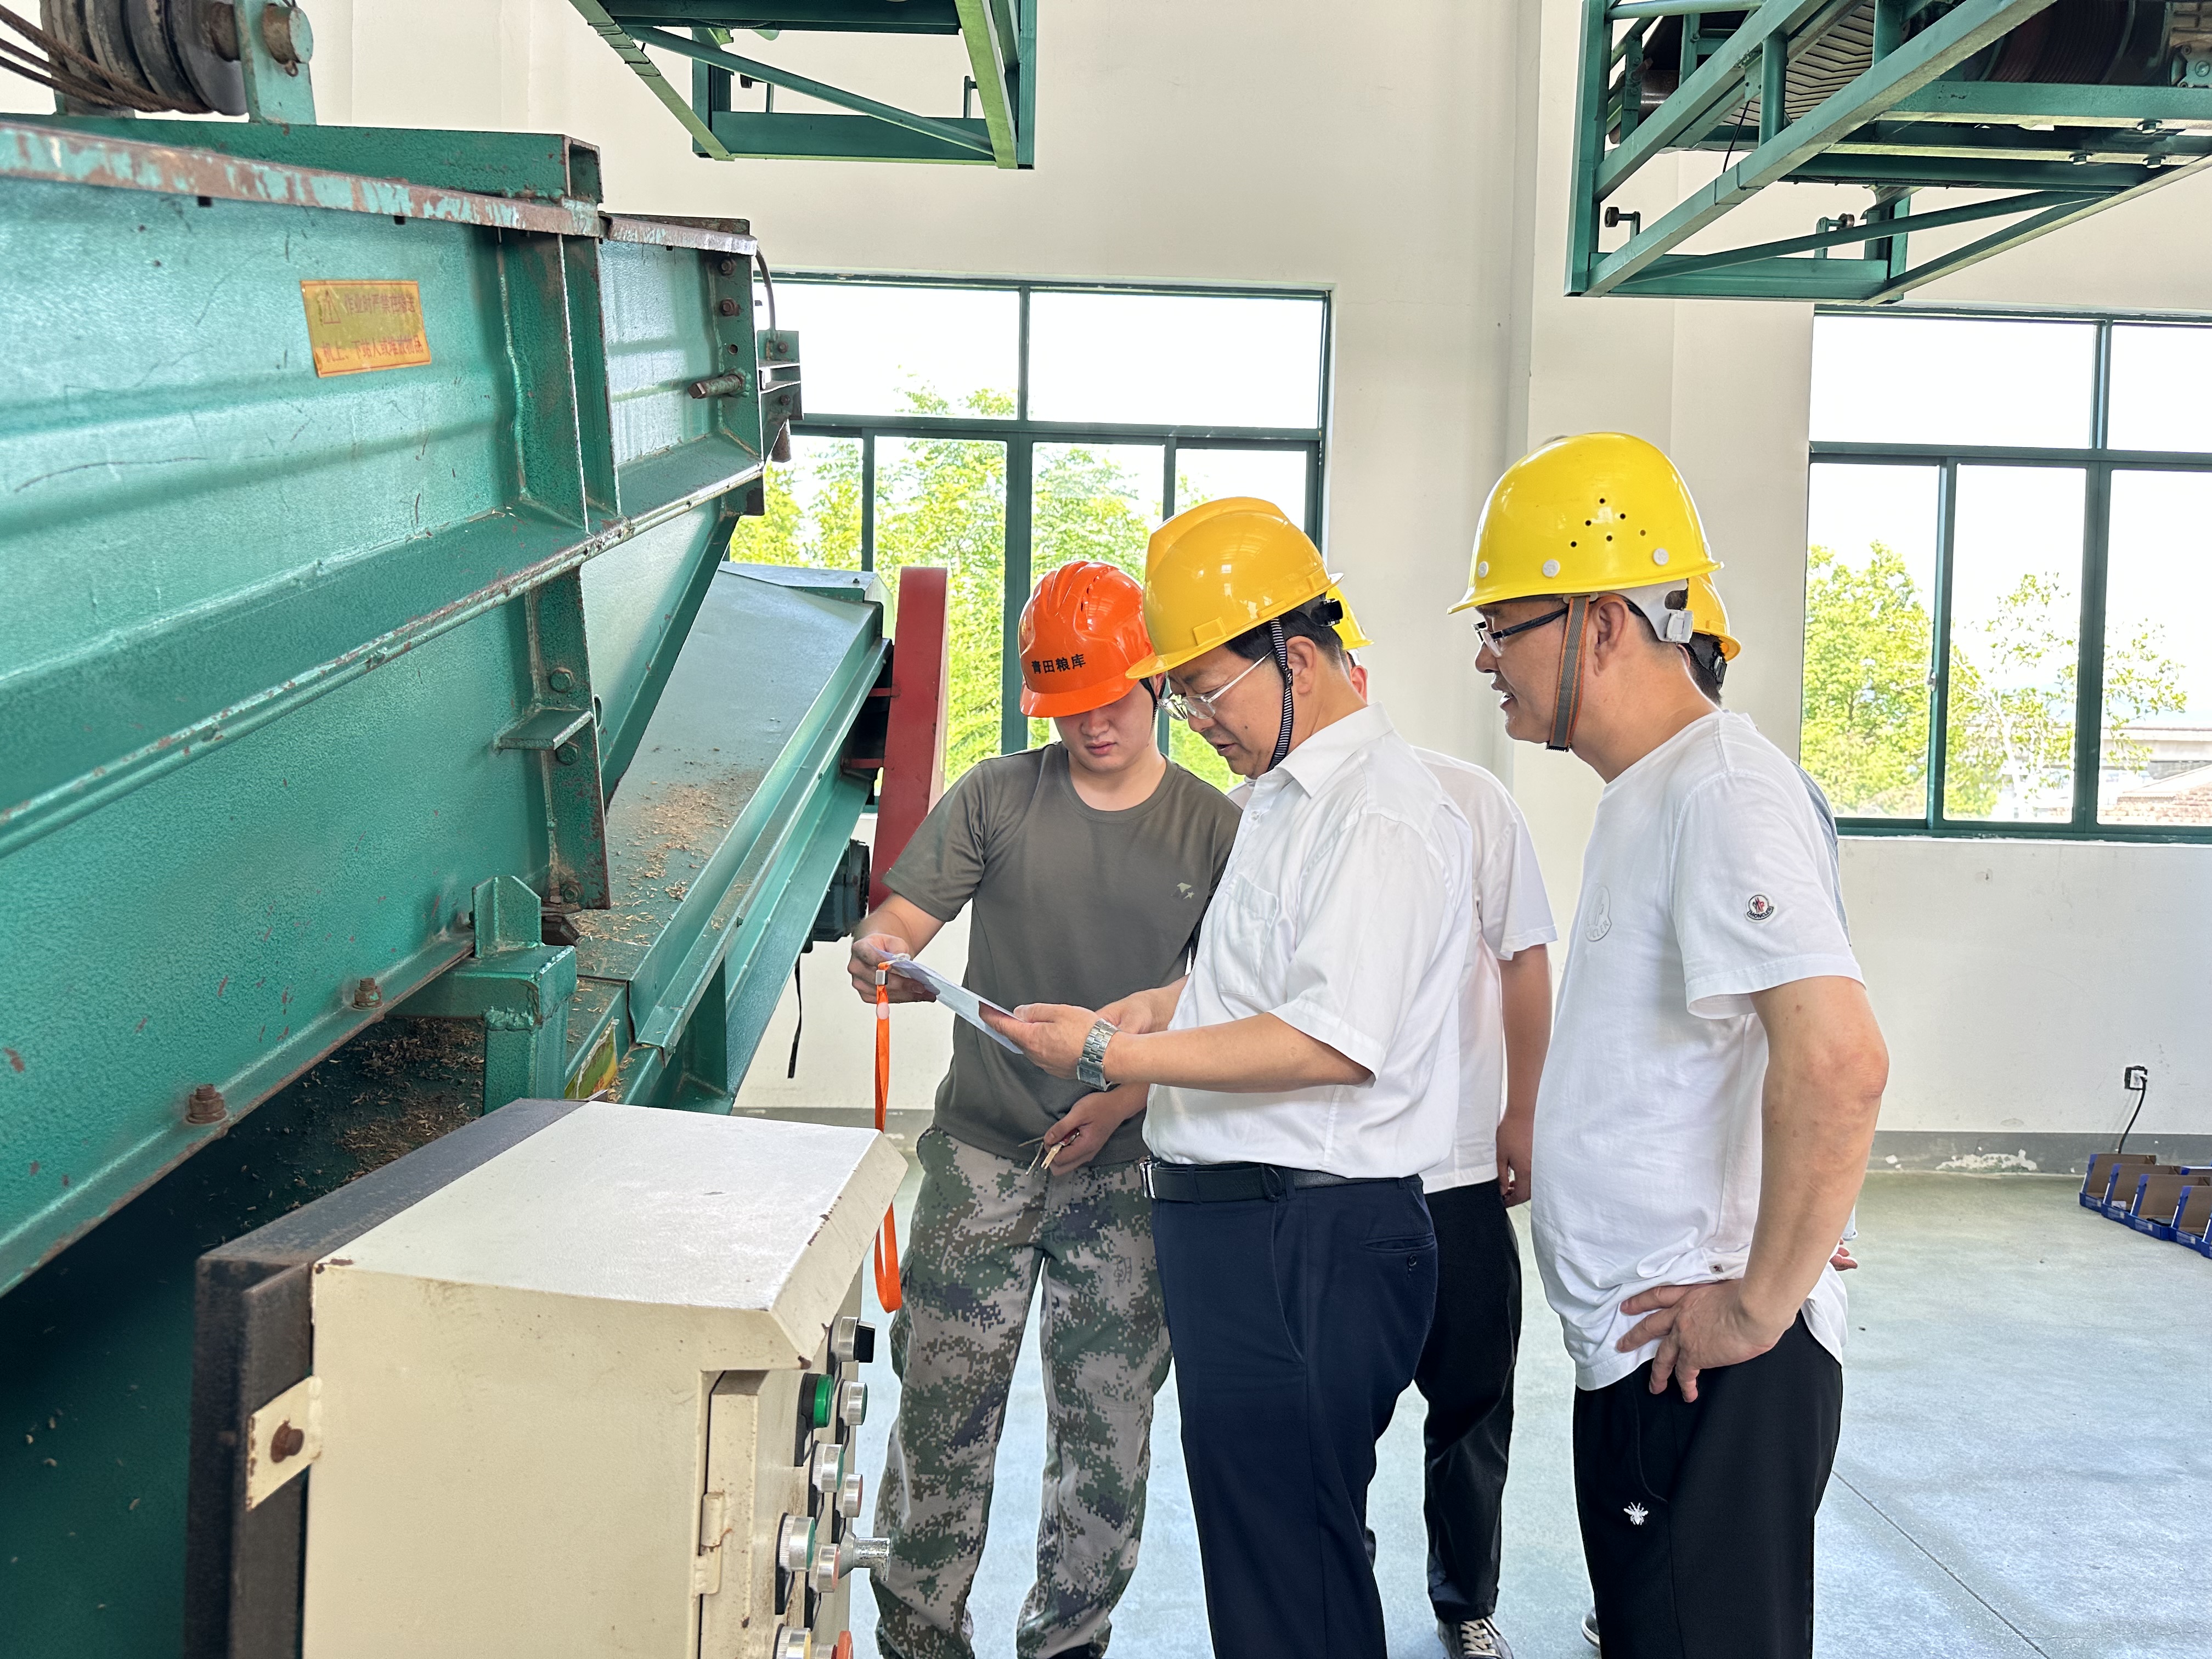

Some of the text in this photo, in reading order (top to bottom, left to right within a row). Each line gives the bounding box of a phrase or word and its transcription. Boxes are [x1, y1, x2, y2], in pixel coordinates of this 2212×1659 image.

[1031, 653, 1086, 674] 青田粮库
[1748, 907, 1771, 918] MONCLER
